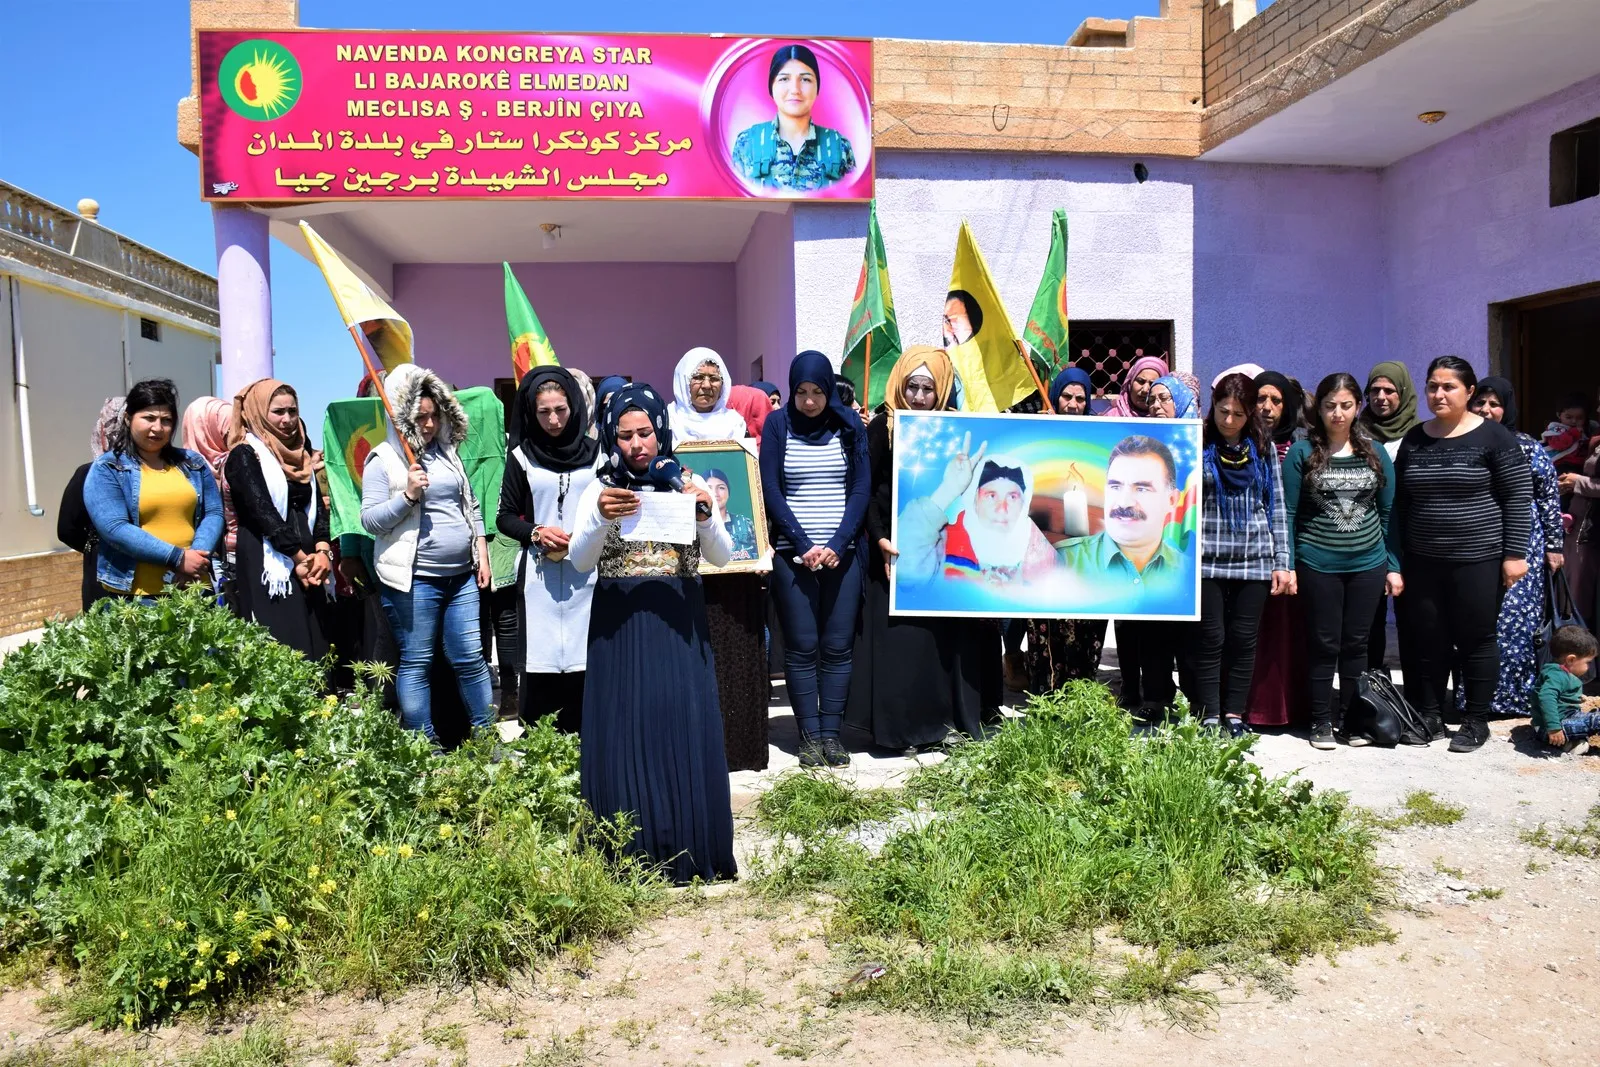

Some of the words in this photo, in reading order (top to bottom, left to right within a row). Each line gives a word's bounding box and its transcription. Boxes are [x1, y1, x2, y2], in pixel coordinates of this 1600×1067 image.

[337, 45, 448, 62] NAVENDA
[457, 46, 584, 63] KONGREYA
[593, 47, 652, 64] STAR
[355, 73, 375, 89] LI
[385, 69, 510, 90] BAJAROKÊ
[519, 74, 628, 91] ELMEDAN
[347, 100, 450, 117] MECLISA
[459, 100, 473, 121] Ş
[497, 97, 582, 117] BERJÎN
[590, 101, 644, 121] ÇIYA
[338, 130, 404, 157] بلدة
[410, 129, 454, 159] في
[456, 131, 524, 154] ستار
[532, 130, 621, 155] كونكرا
[624, 131, 692, 156] مركز
[275, 167, 336, 192] جيا
[343, 167, 440, 193] برجين
[444, 164, 560, 191] الشهيدة
[566, 167, 669, 192] مجلس
